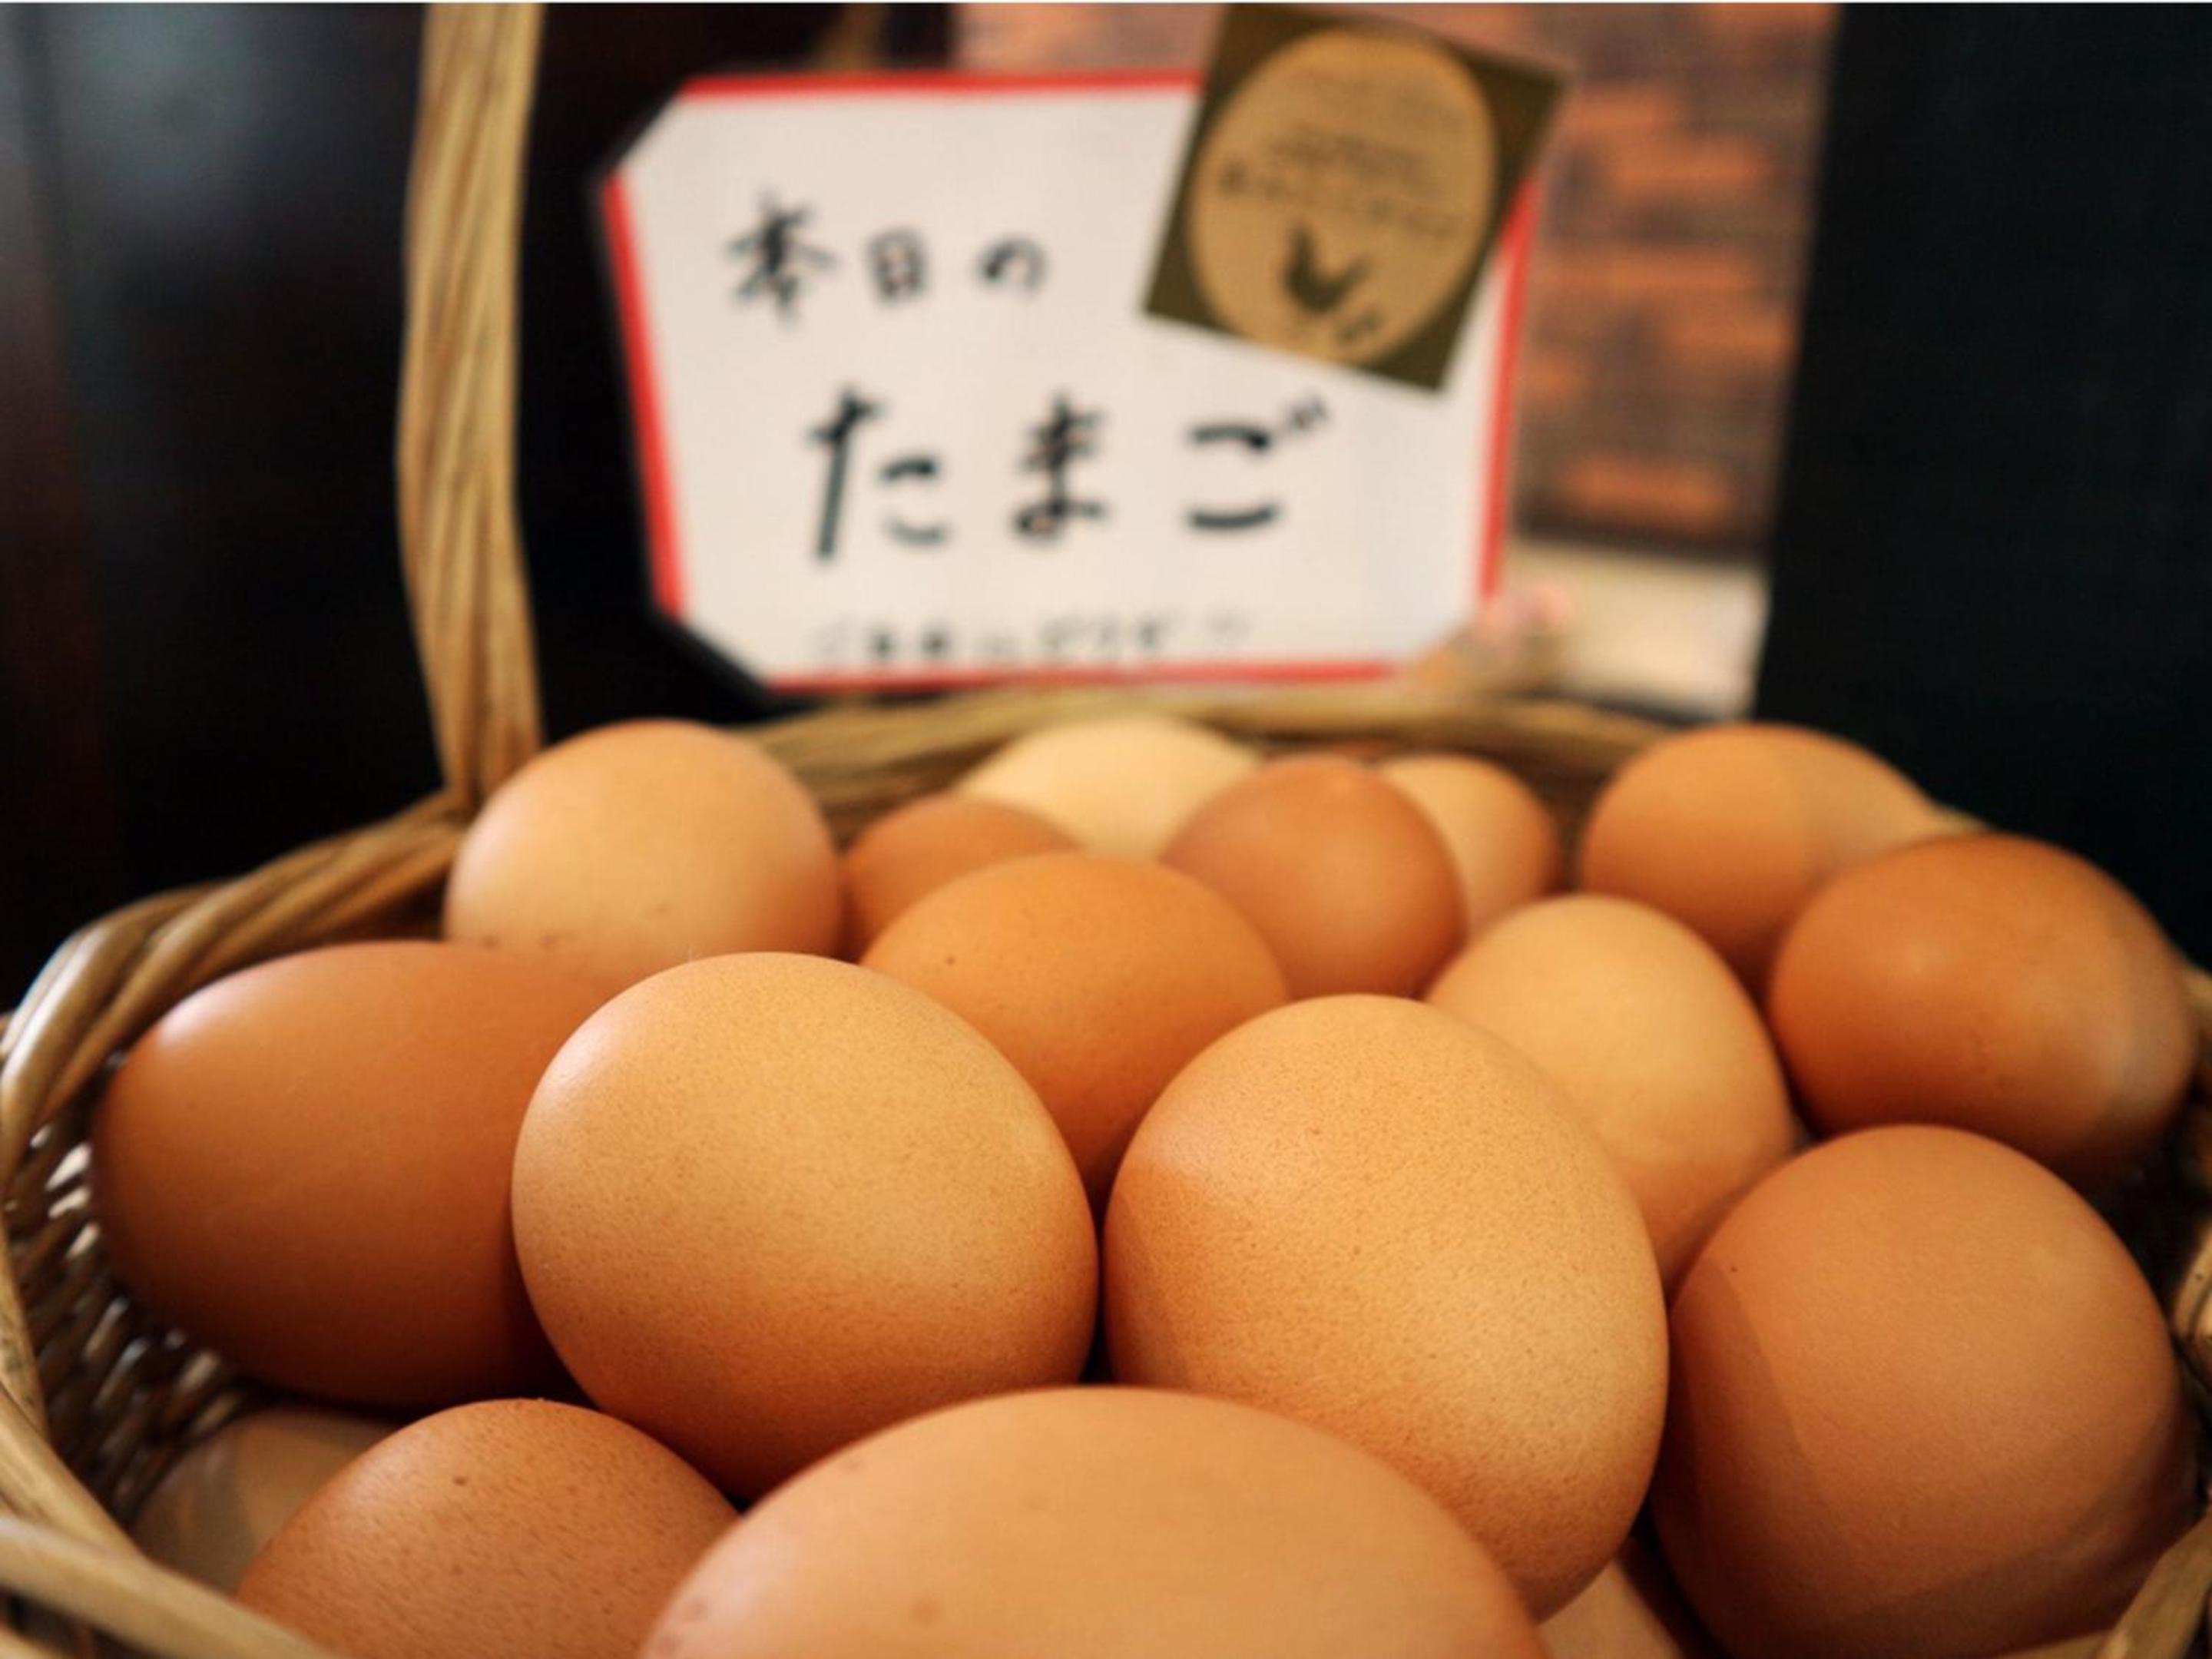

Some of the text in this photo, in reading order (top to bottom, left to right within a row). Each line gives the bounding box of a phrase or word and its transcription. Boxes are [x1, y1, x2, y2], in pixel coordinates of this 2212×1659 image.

[725, 187, 1049, 316] 本日の
[806, 386, 1329, 561] たまご
